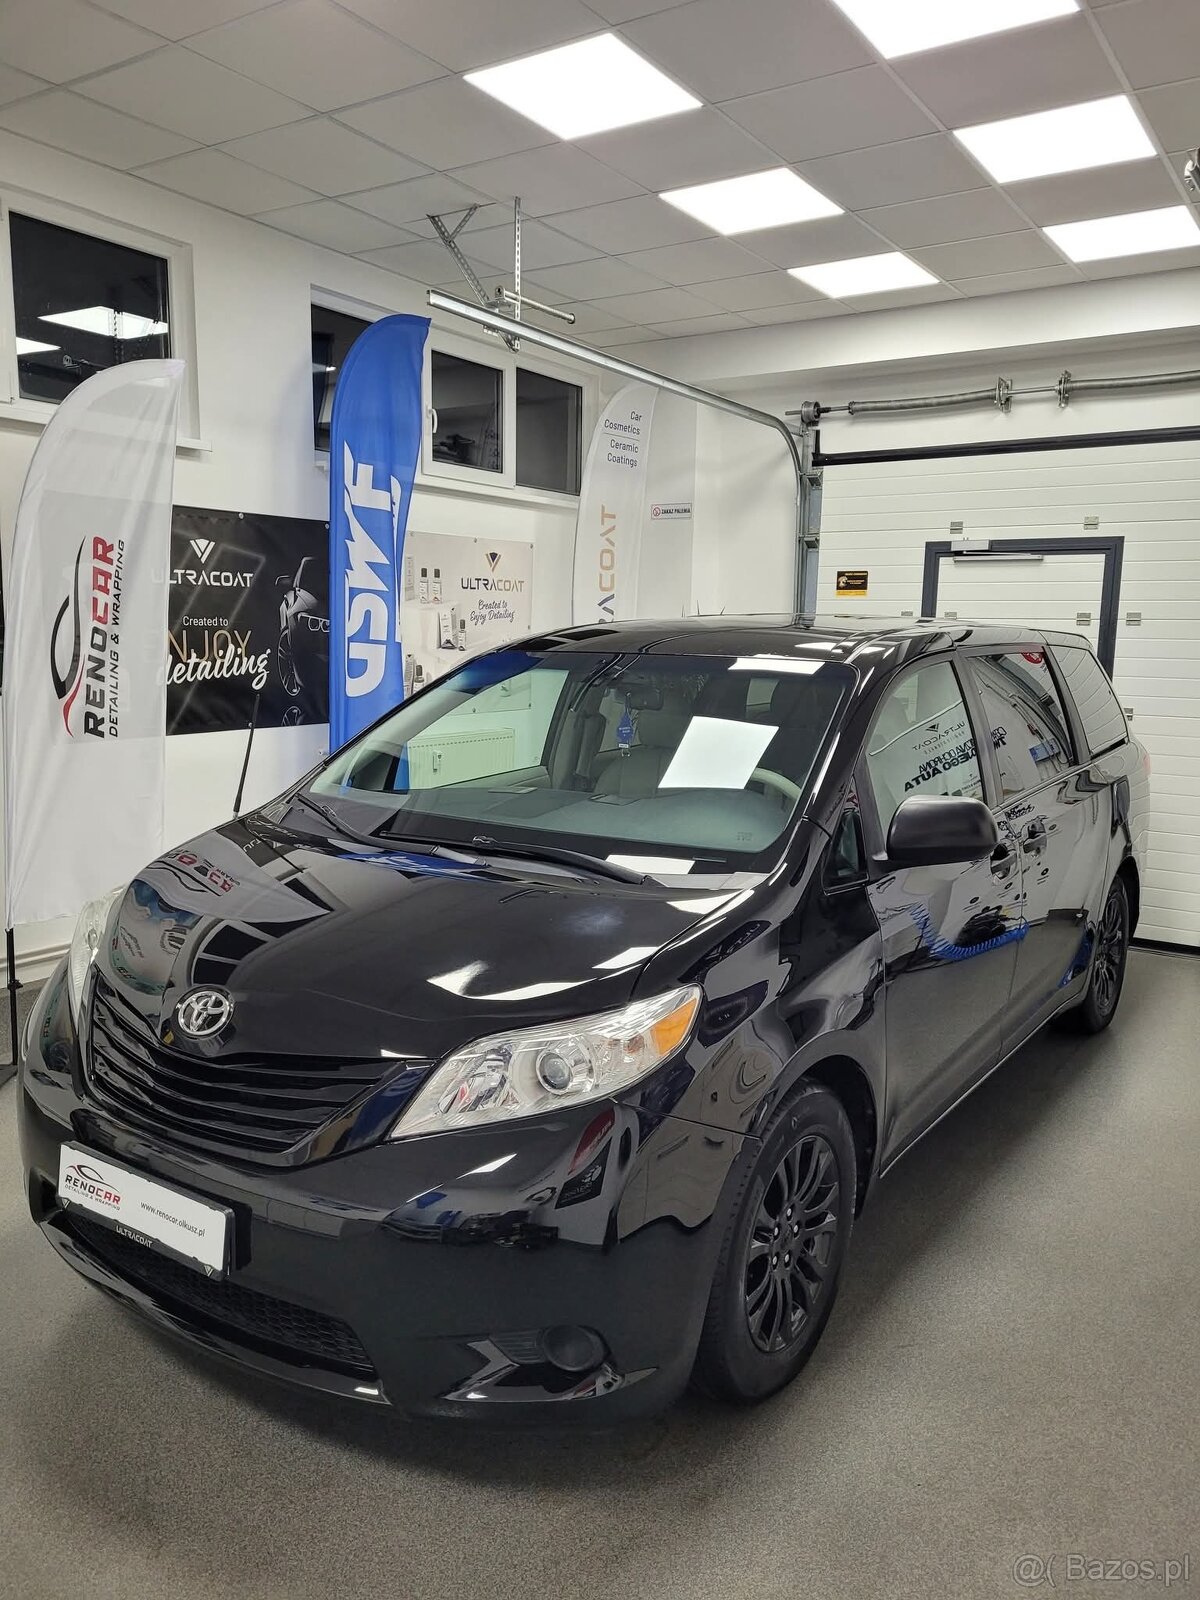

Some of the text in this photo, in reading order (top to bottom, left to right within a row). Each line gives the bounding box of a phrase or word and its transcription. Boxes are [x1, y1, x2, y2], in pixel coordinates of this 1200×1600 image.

[630, 410, 642, 421] Car
[604, 418, 641, 435] Cosmetics
[610, 438, 639, 454] Ceramic
[607, 452, 638, 468] Coatings
[344, 439, 392, 698] GSWF
[460, 577, 525, 593] ULTRACOAT
[478, 598, 508, 611] Created to
[182, 615, 229, 627] Created to
[469, 610, 487, 626] Enjoy
[84, 535, 115, 739] RENOCAR
[109, 539, 125, 738] DETAILING & WRAPPING
[165, 629, 252, 663] NJOY
[65, 1174, 121, 1205] RENOCAR
[140, 1200, 206, 1237] www.renocar.olkusz.pl
[115, 1224, 153, 1248] ULTRACOAT
